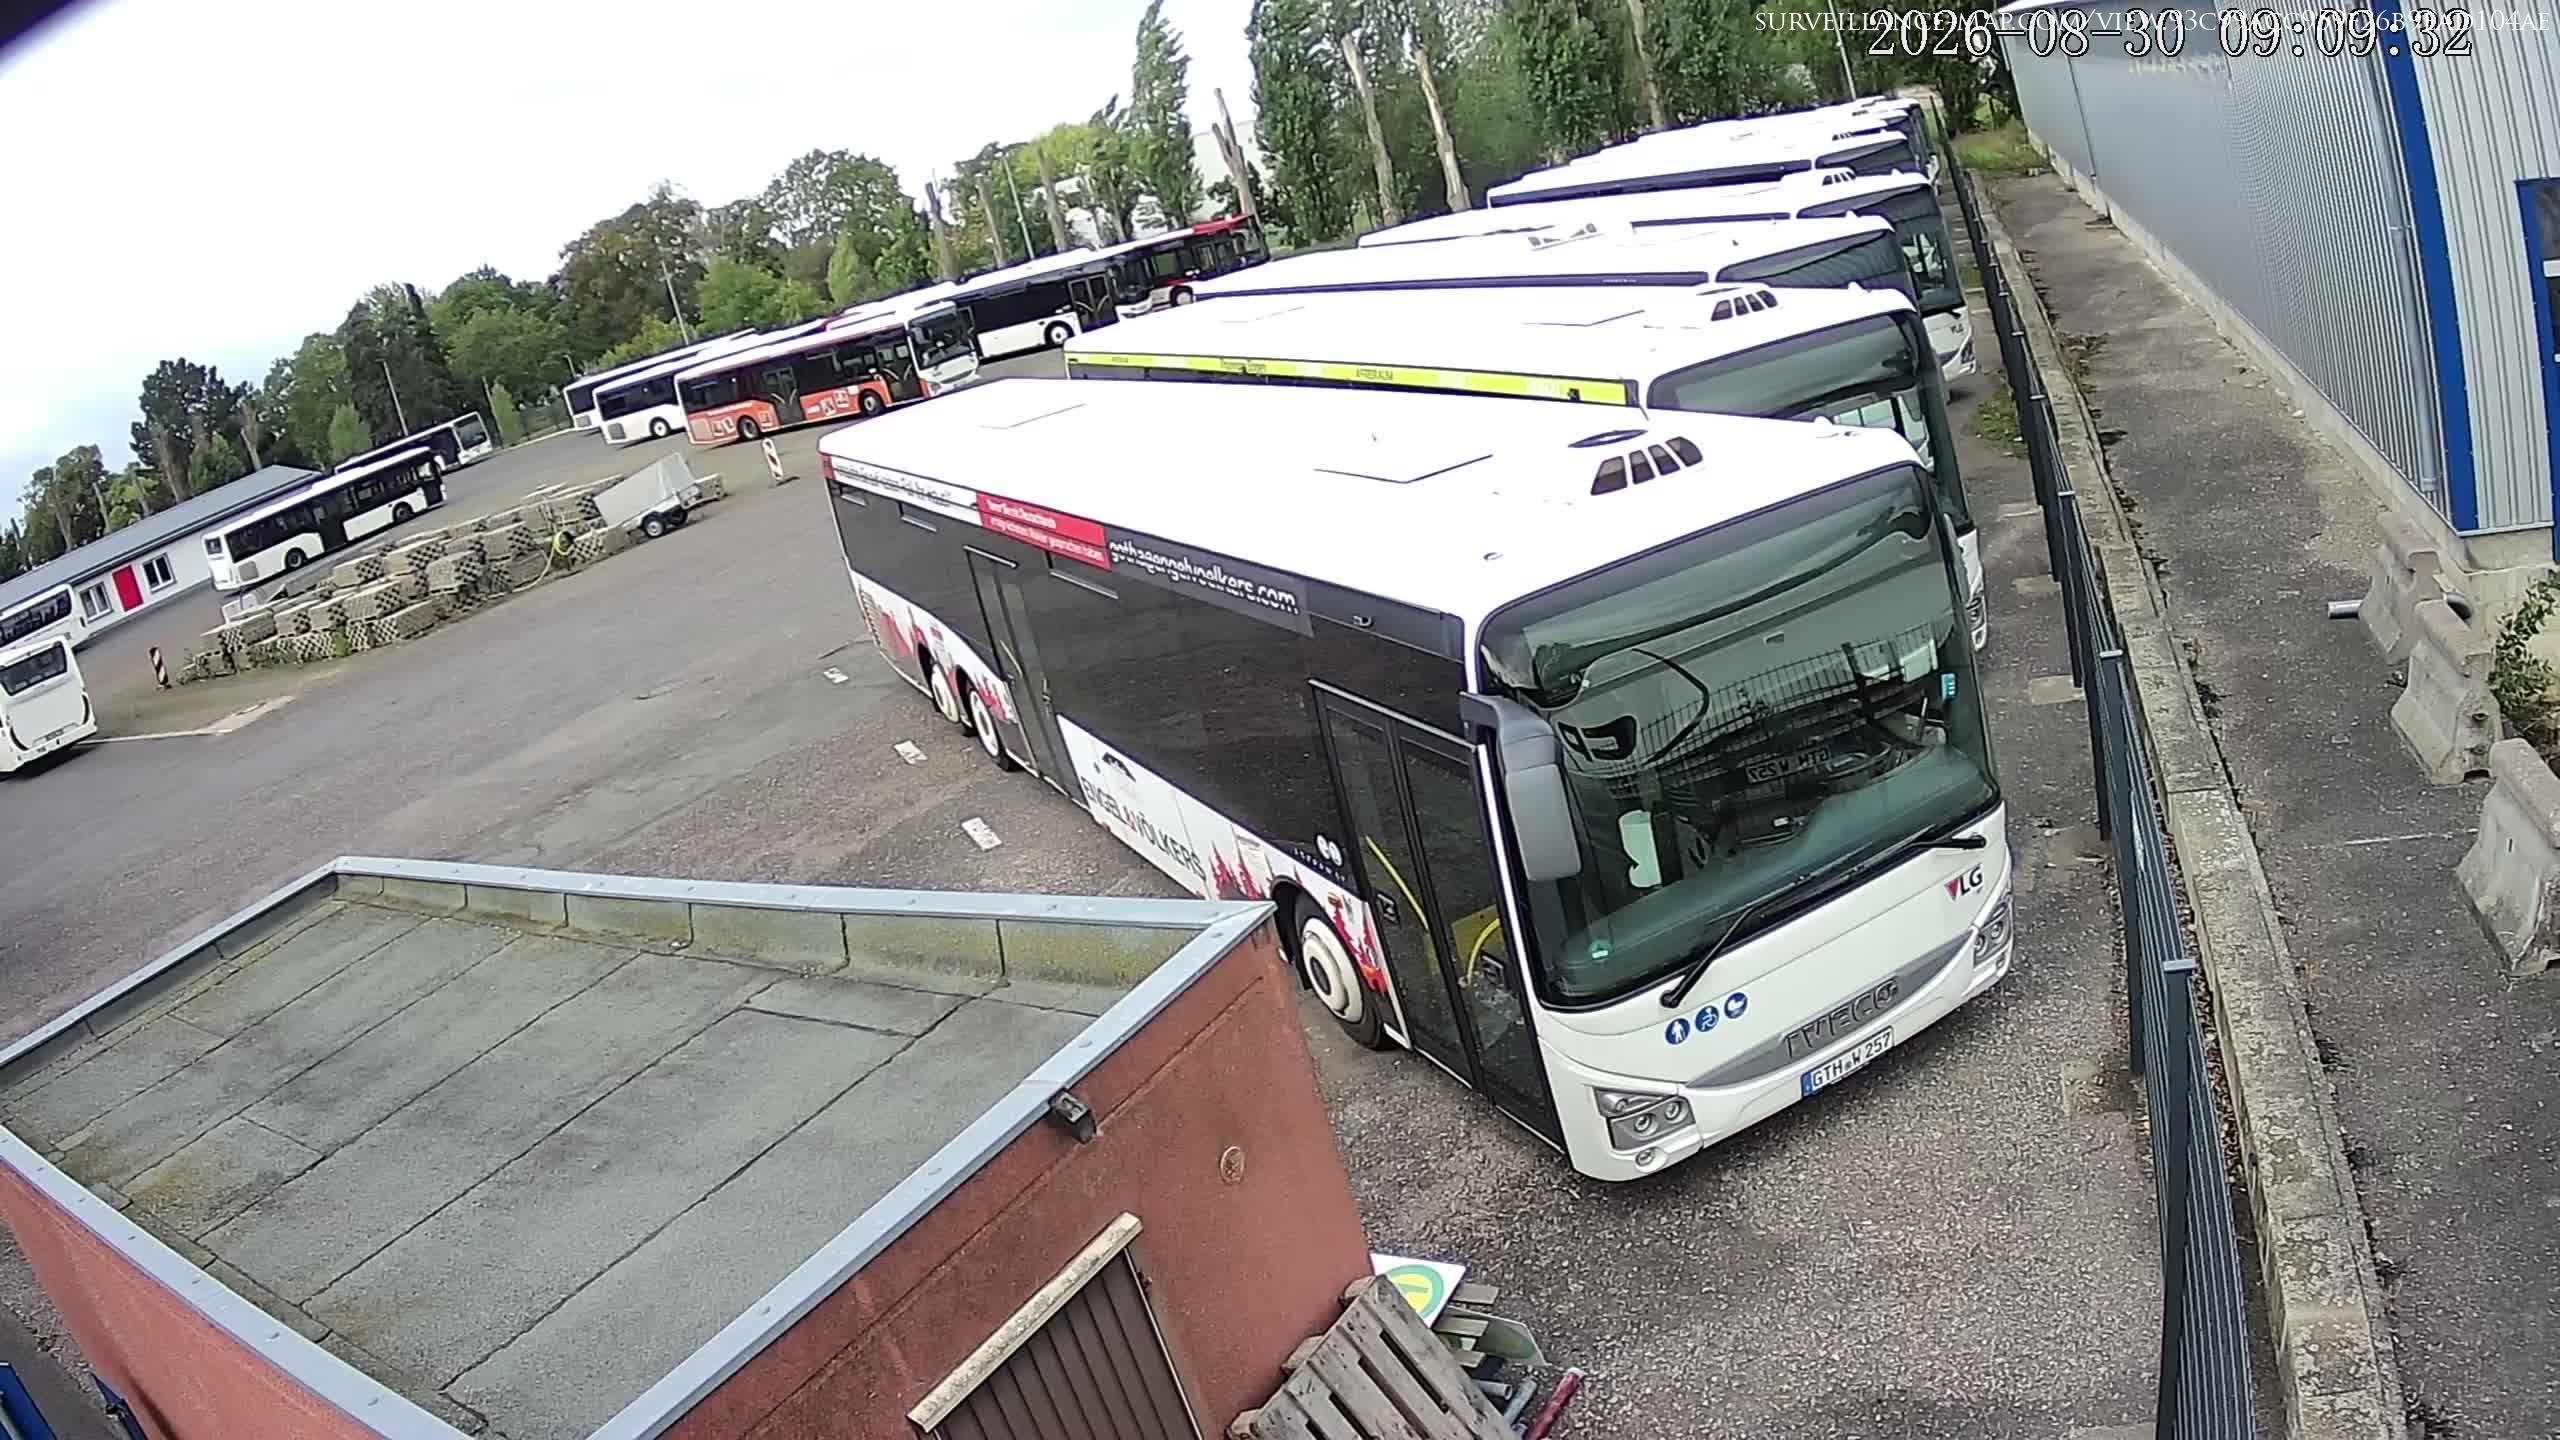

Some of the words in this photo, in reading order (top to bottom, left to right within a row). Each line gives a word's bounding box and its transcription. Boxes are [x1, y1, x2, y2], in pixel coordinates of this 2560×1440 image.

[1784, 977, 1899, 1059] IVECO
[1812, 1058, 1843, 1088] GTH
[1865, 1031, 1891, 1059] 257
